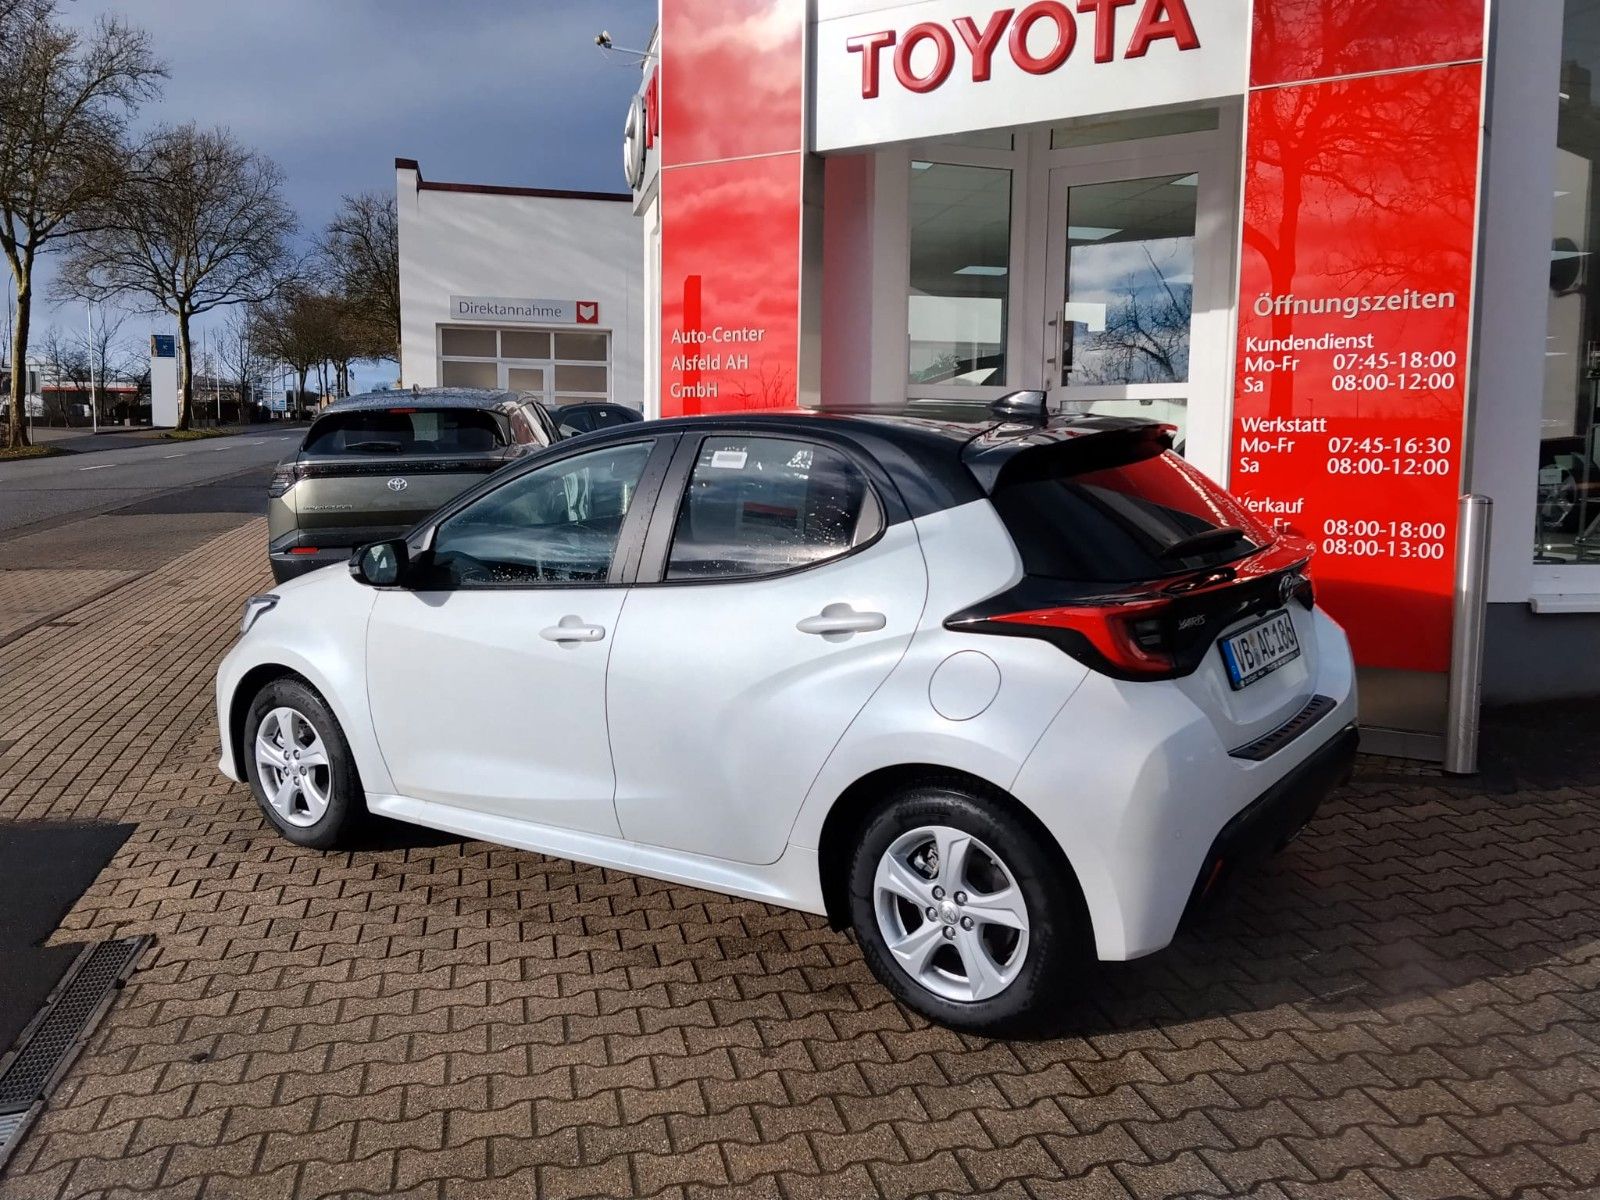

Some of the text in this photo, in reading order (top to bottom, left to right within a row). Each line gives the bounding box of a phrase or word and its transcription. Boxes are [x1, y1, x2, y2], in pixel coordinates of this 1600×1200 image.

[846, 0, 1201, 99] TOYOTA
[458, 301, 562, 318] Direktannahme
[1253, 288, 1456, 318] Öffnungszeiten
[671, 326, 765, 344] Auto-Center
[1245, 333, 1374, 352] Kundendienst
[671, 353, 749, 371] Alsfeld AH
[1244, 350, 1456, 373] Mo-Fr 07:45-18:00
[670, 381, 718, 398] GmbH
[1243, 372, 1455, 393] Sa 08:00-12:00
[1240, 416, 1327, 433] Werkstatt
[1240, 437, 1451, 454] Mo-Fr 07:45-16:30
[1239, 457, 1449, 475] Sa 08:00-12:00
[1323, 519, 1446, 539] 08:00-18:00
[1322, 539, 1444, 559] 08:00-13:00
